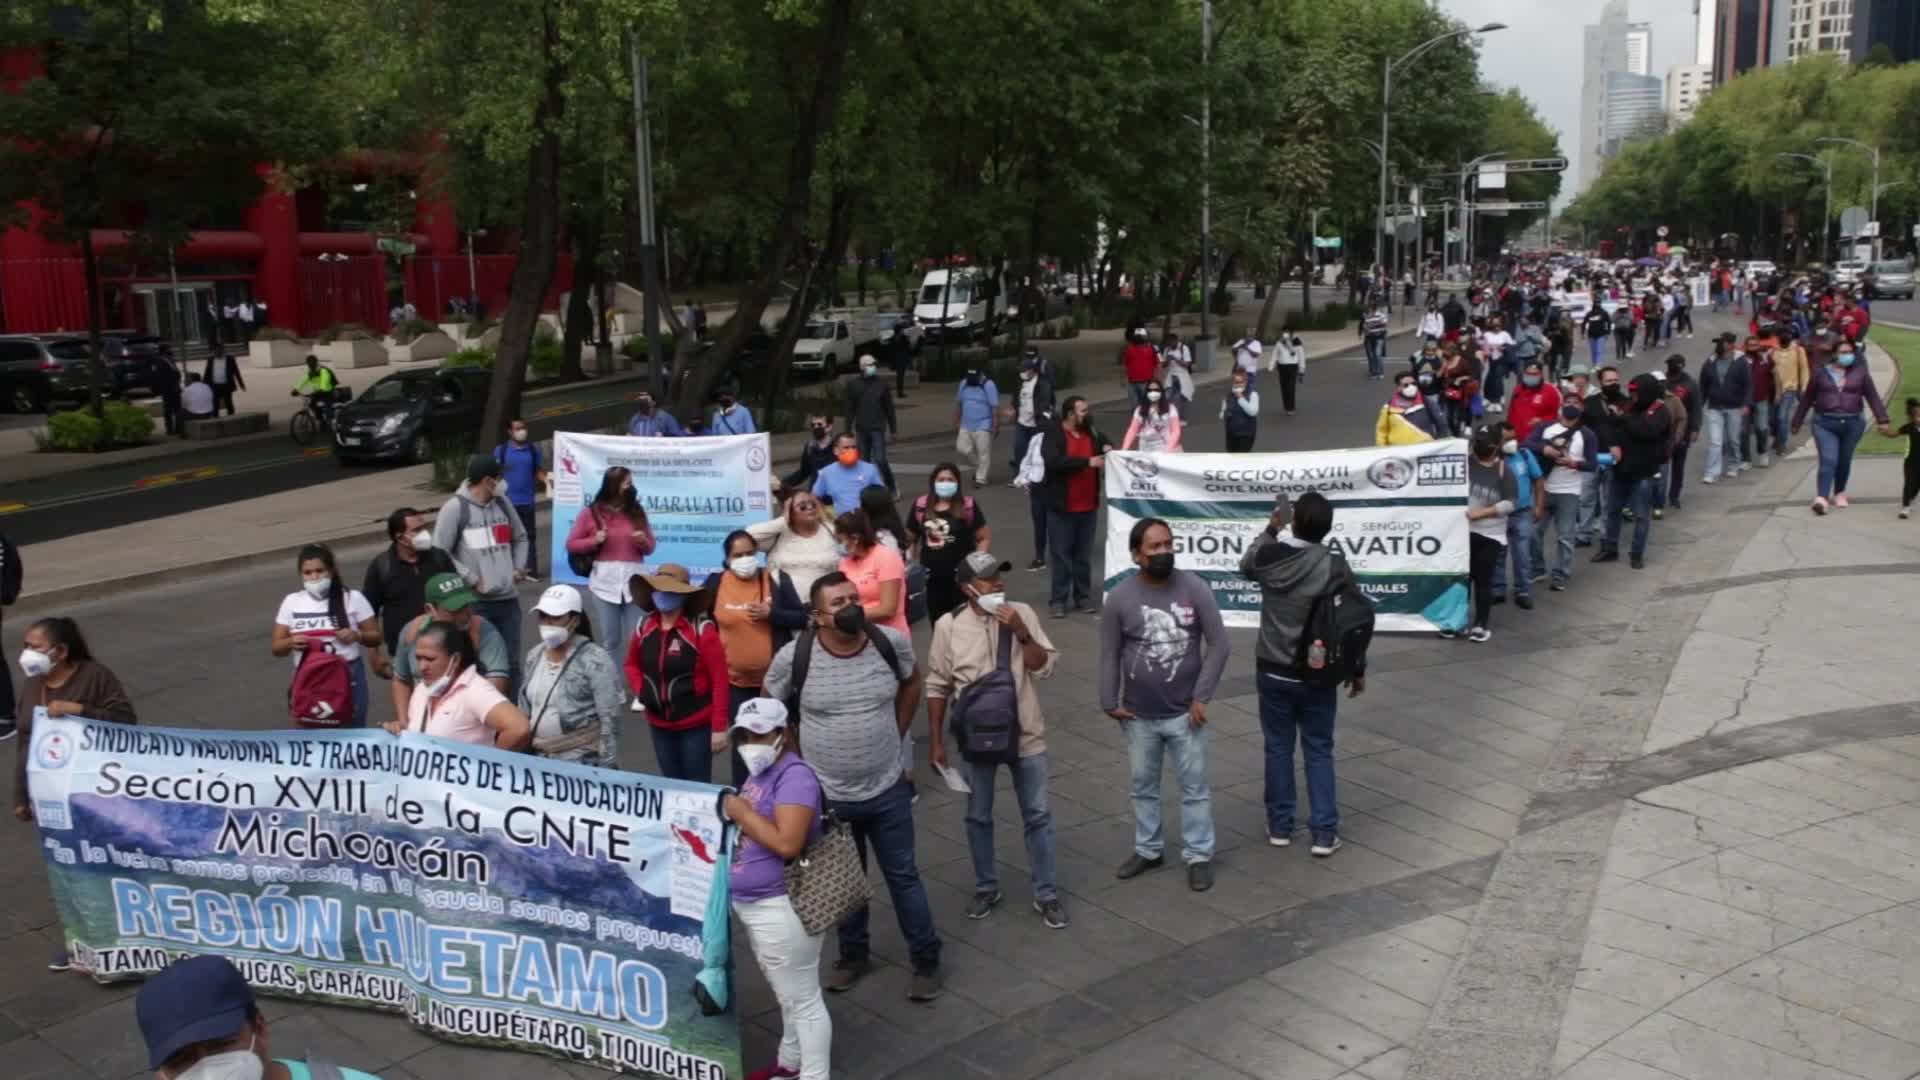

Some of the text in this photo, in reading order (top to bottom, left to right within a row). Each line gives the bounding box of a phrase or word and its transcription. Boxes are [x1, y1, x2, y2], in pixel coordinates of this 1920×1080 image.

[1202, 465, 1350, 482] SECCIÓN XVIII
[1418, 461, 1466, 480] CNTE
[1205, 481, 1355, 494] CNTE MICHOACÁN
[1172, 530, 1442, 556] GIÓN AVATÍO
[1211, 581, 1408, 593] BASIFIC TUALES
[80, 724, 186, 757] SINDICATO
[189, 738, 284, 764] NACIONAL
[288, 740, 315, 768] DE
[318, 740, 471, 786] TRABAJADORES
[476, 760, 503, 791] DE
[509, 764, 536, 798] LA
[541, 771, 664, 821] EDUCACIÓN
[95, 761, 649, 872] Sección XVIII de la CNTE,
[215, 812, 489, 884] Michoacán
[79, 839, 108, 864] la
[172, 858, 249, 882] somos
[361, 872, 389, 894] en
[391, 870, 415, 897] la
[510, 899, 591, 932] somos
[595, 915, 706, 961] propuest
[111, 877, 668, 1030] REGIÓN HUETAMO
[237, 960, 305, 993] UCAS,
